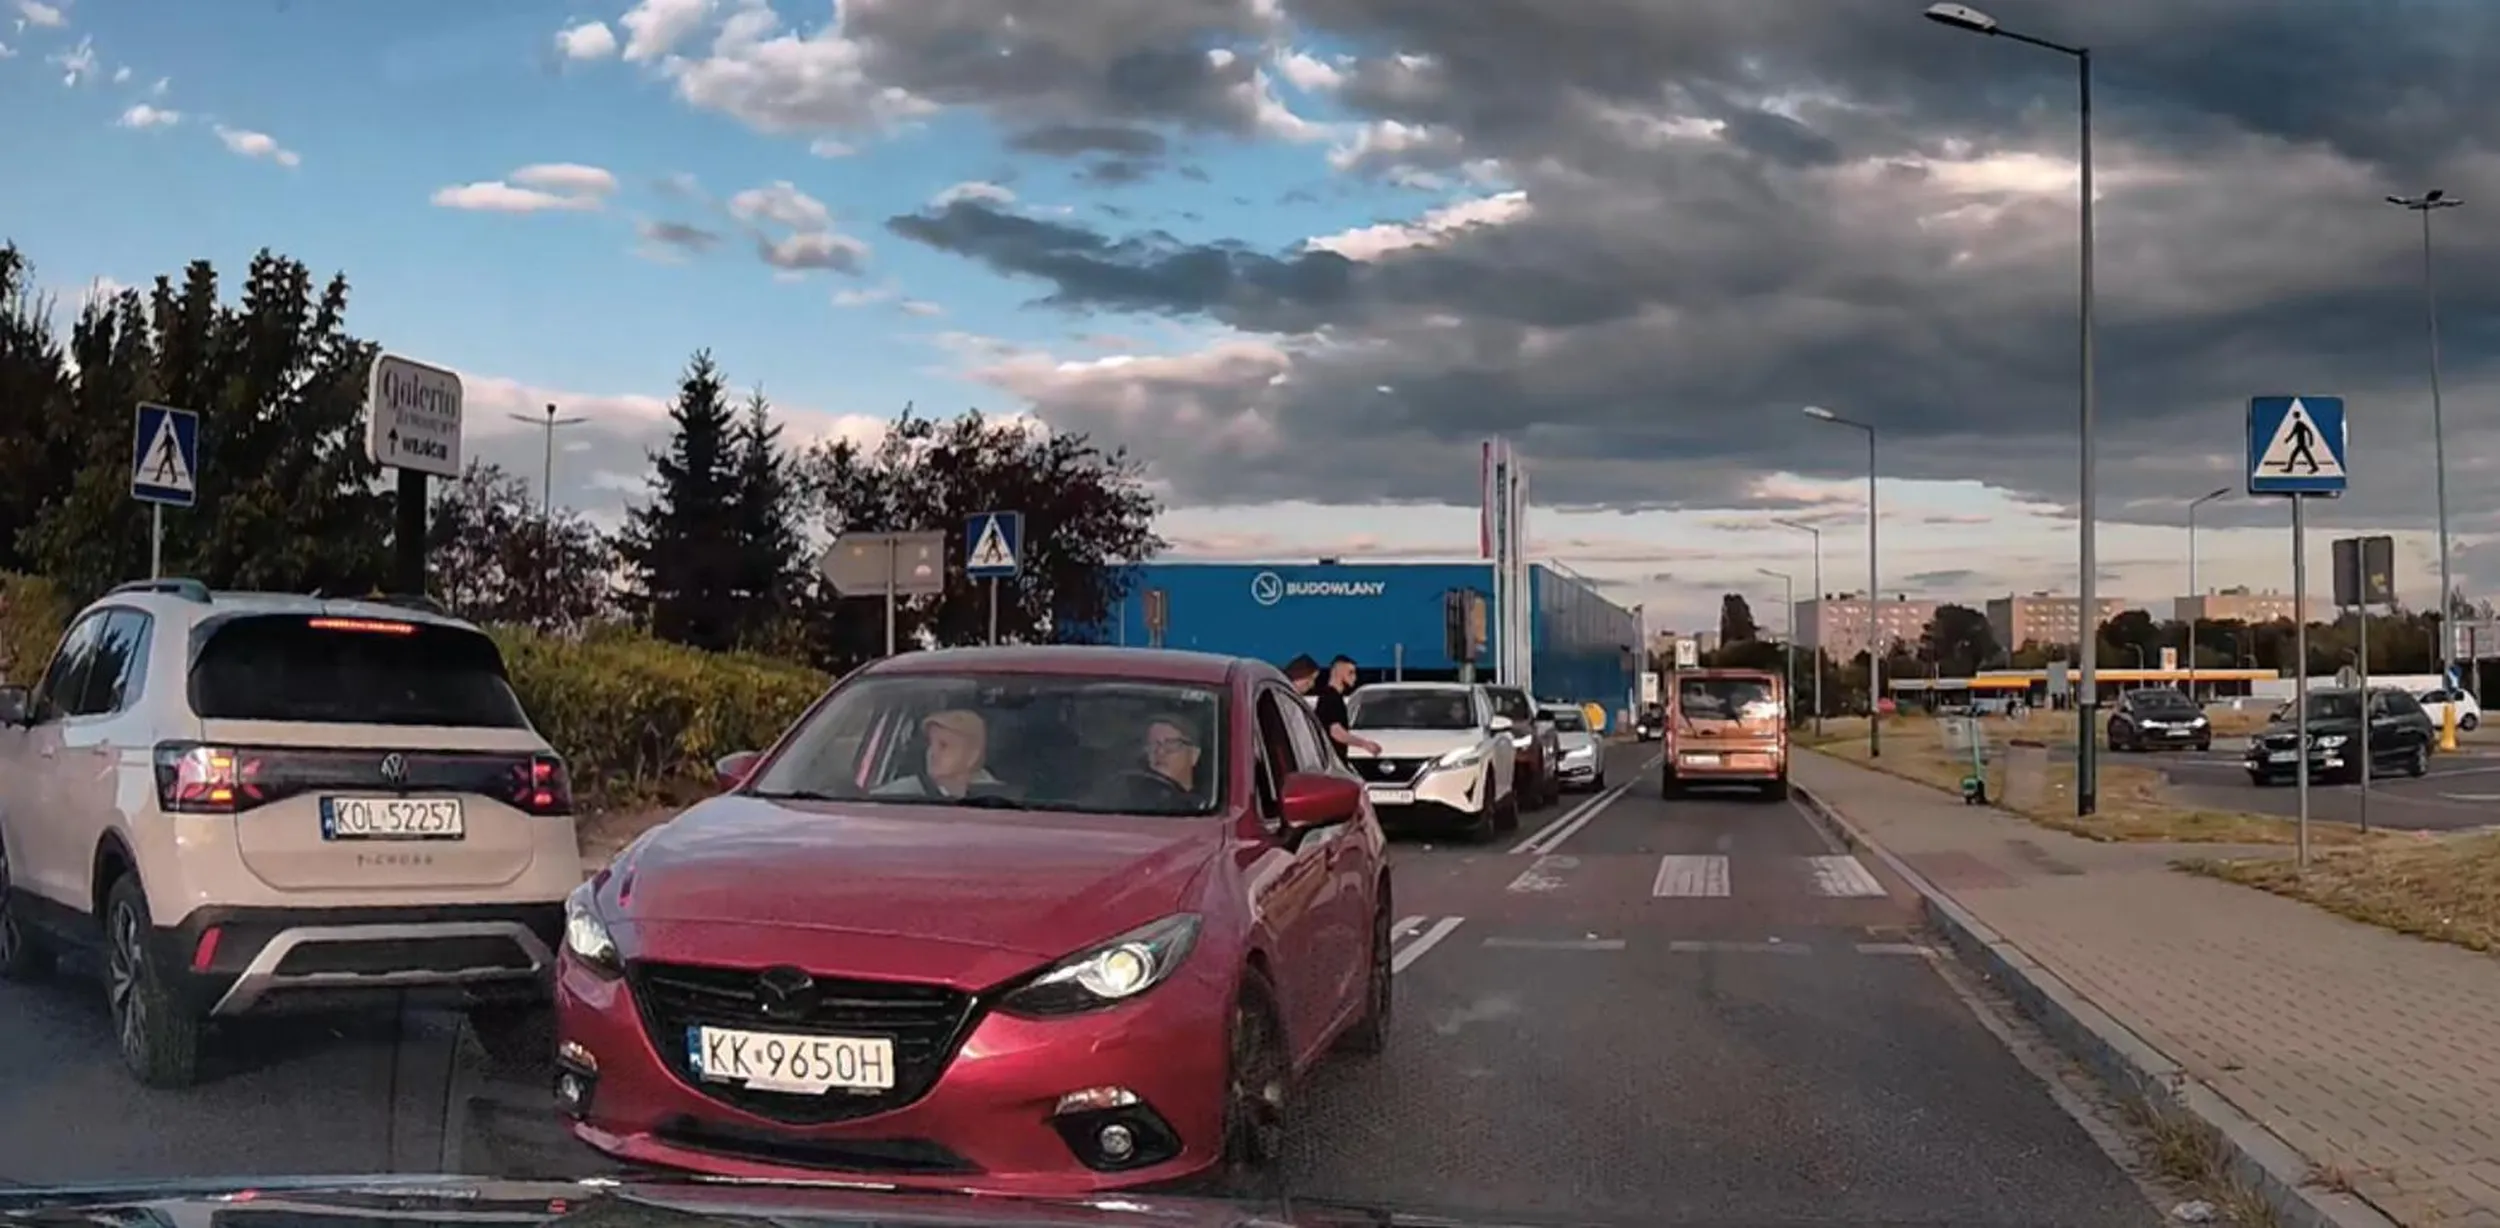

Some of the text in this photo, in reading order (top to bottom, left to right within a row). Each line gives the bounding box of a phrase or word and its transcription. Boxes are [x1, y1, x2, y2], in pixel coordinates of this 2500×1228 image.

[1286, 581, 1385, 596] BUDOWLANY
[336, 801, 381, 832] KOL
[388, 802, 457, 832] 52257
[708, 1032, 752, 1076] KK
[766, 1040, 884, 1083] 9650H
